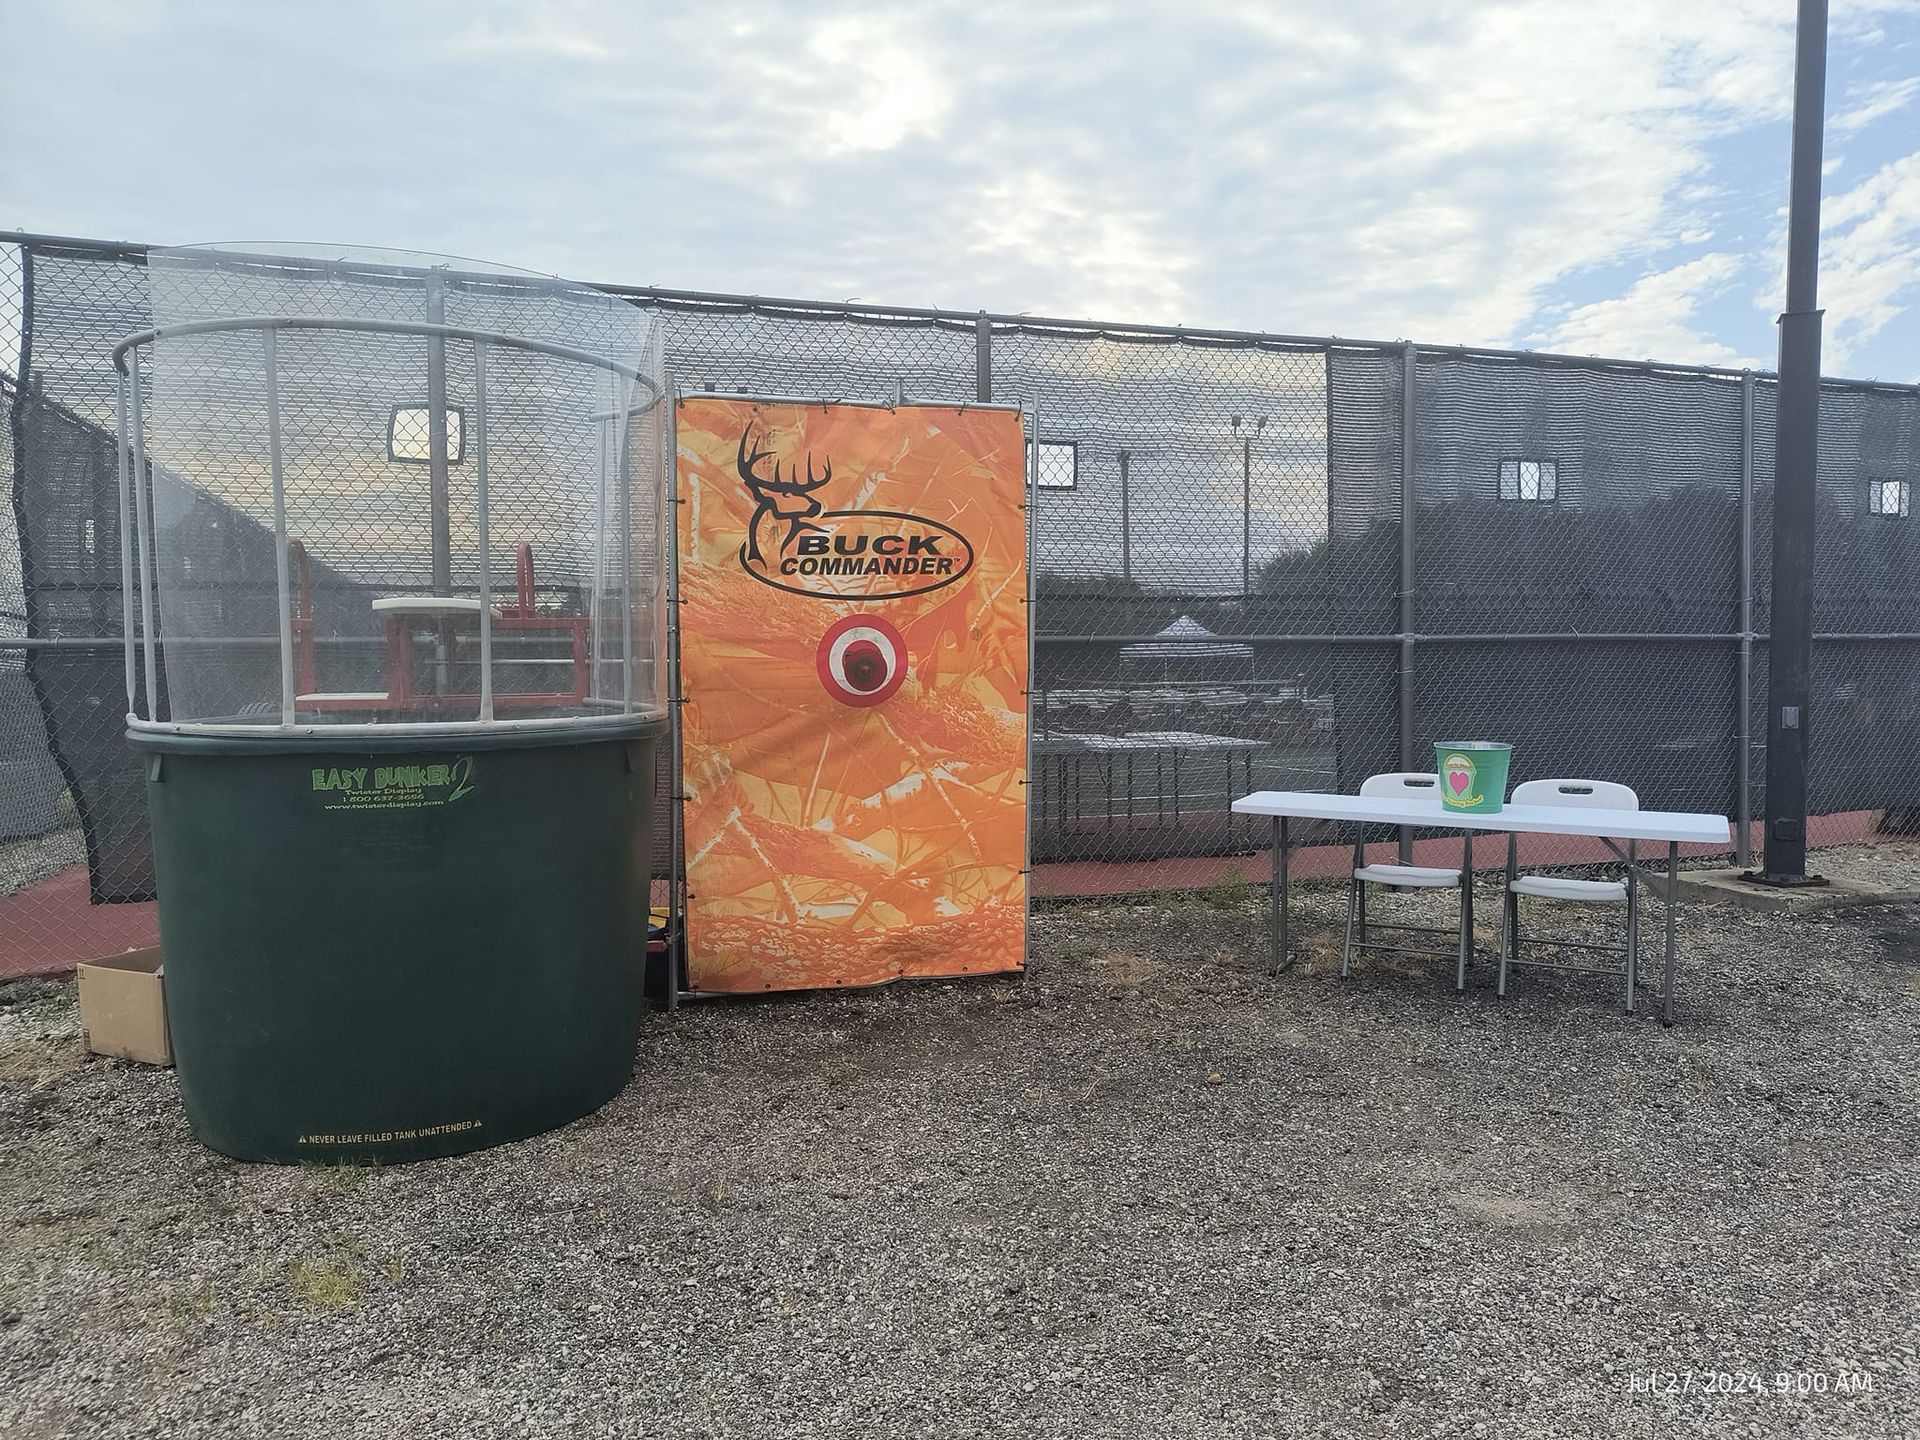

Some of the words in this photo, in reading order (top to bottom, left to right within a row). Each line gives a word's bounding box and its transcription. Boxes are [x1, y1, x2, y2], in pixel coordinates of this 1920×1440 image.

[797, 536, 943, 556] BUCK
[780, 557, 953, 576] COMMANDER
[312, 768, 367, 790] EASY
[375, 765, 450, 789] DUNKER
[345, 788, 382, 796] Twister
[384, 787, 422, 795] Display
[324, 800, 444, 810] www.twisterdisplay.com
[309, 1134, 336, 1144] NEVER
[337, 1134, 363, 1144] LEAVE
[364, 1132, 393, 1143] FILLED
[394, 1130, 417, 1140] TANK
[418, 1121, 472, 1137] UNATTENDED
